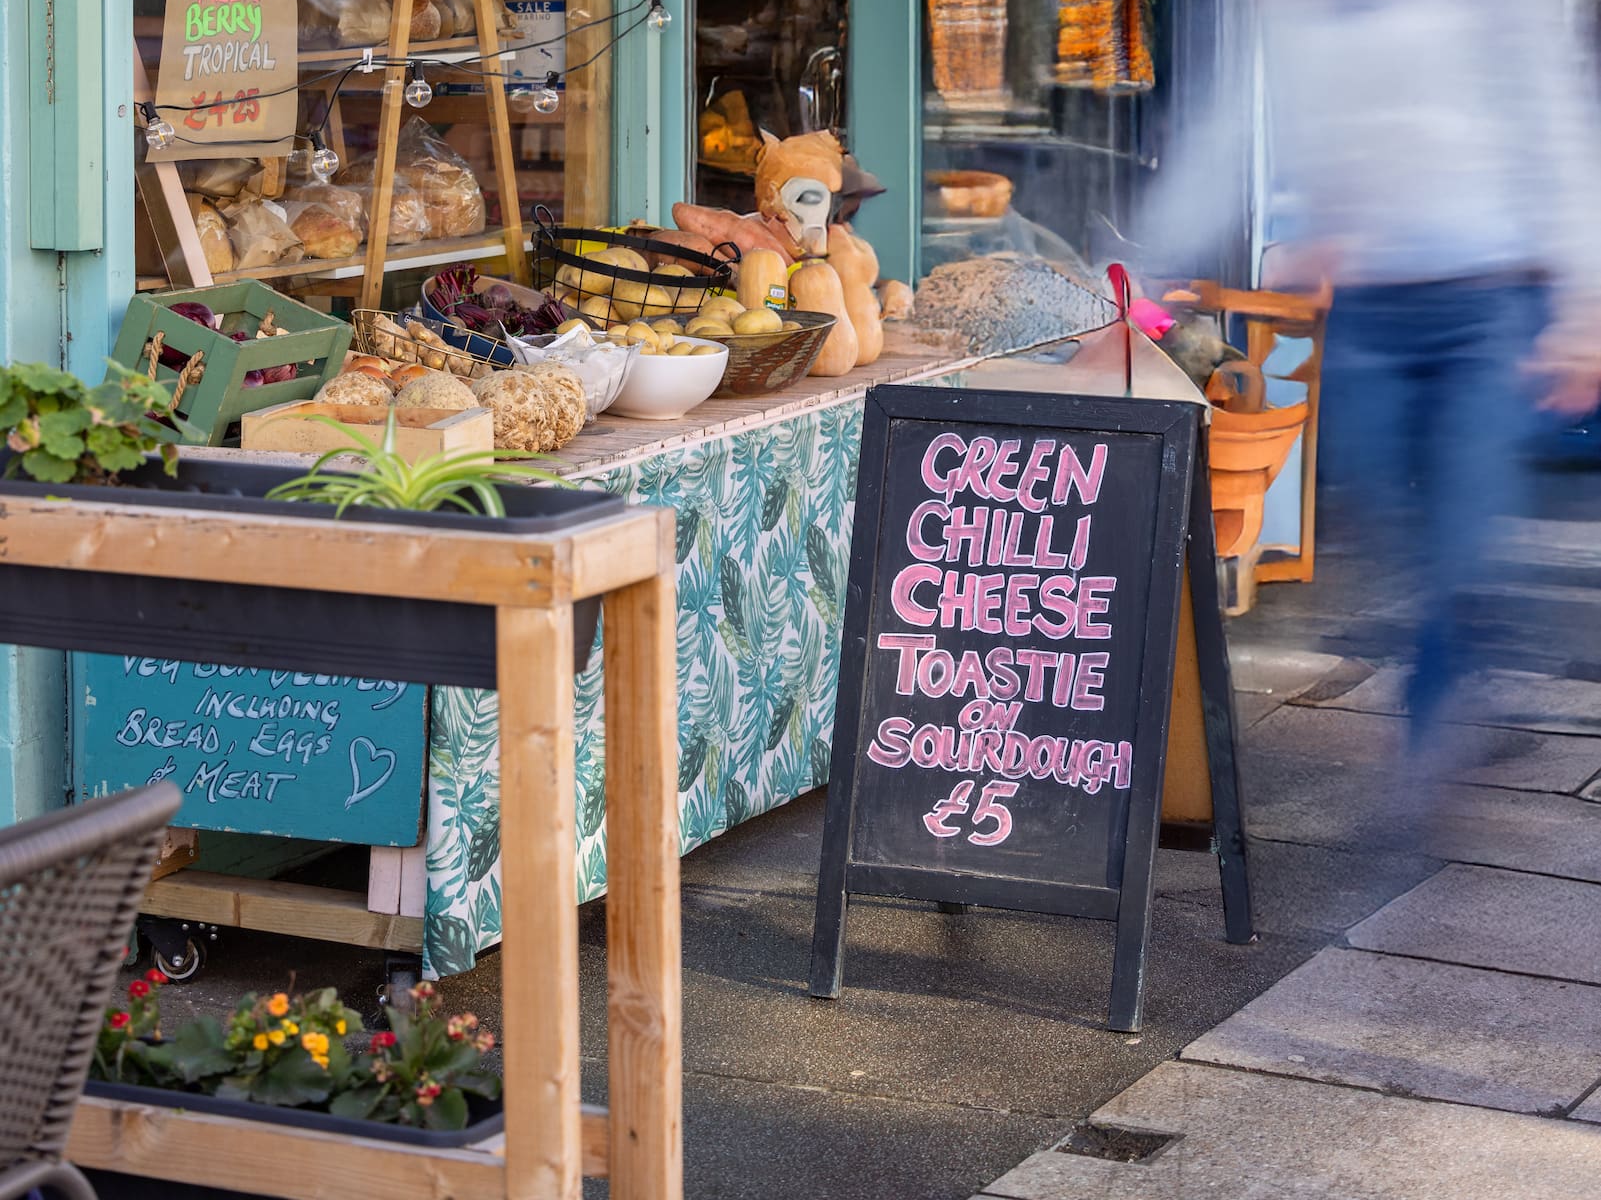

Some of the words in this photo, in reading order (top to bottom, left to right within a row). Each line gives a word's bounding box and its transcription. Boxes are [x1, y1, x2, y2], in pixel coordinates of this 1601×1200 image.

[185, 2, 262, 42] BERRY
[517, 1, 551, 12] SALE
[184, 41, 276, 80] TROPICAL
[921, 432, 1108, 512] GREEN
[906, 500, 1091, 570] CHILLI
[891, 564, 1117, 639] CHEESE
[878, 633, 1110, 711] TOASTIE
[194, 686, 340, 731] INCLUDING
[958, 700, 1023, 732] ON
[184, 759, 297, 803] MEAT
[867, 717, 1132, 794] SOURDOUGH
[923, 780, 1020, 846] £5
